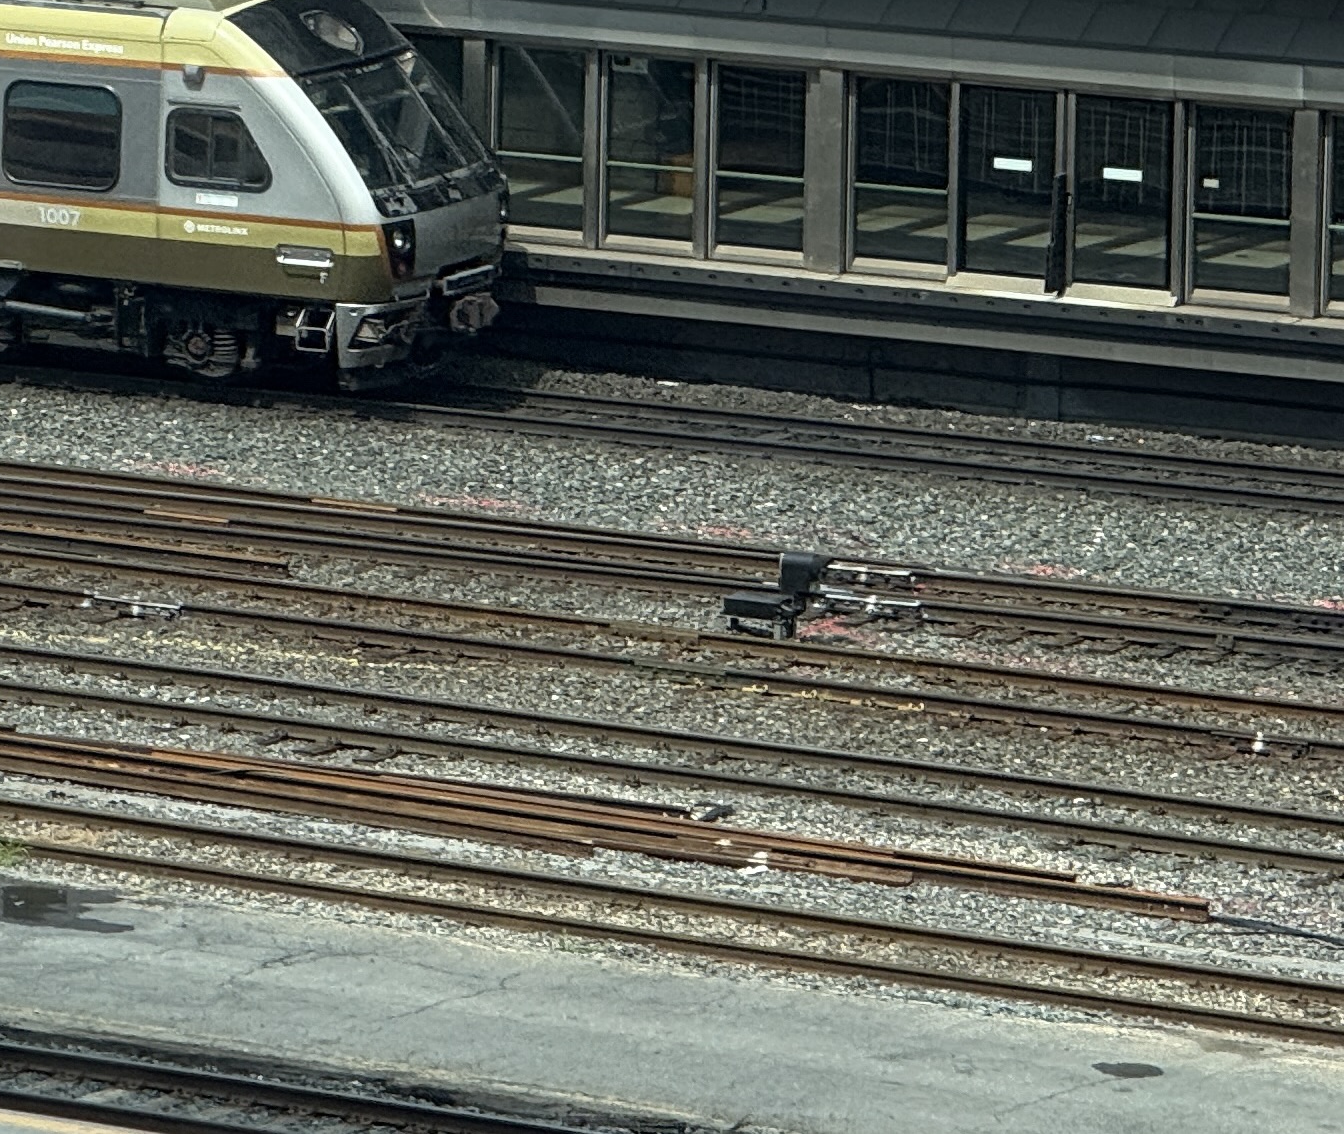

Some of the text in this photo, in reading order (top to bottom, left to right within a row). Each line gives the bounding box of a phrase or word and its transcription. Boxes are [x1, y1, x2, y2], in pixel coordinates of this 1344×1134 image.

[5, 32, 124, 54] Union Pearson Express
[38, 206, 80, 227] 1007
